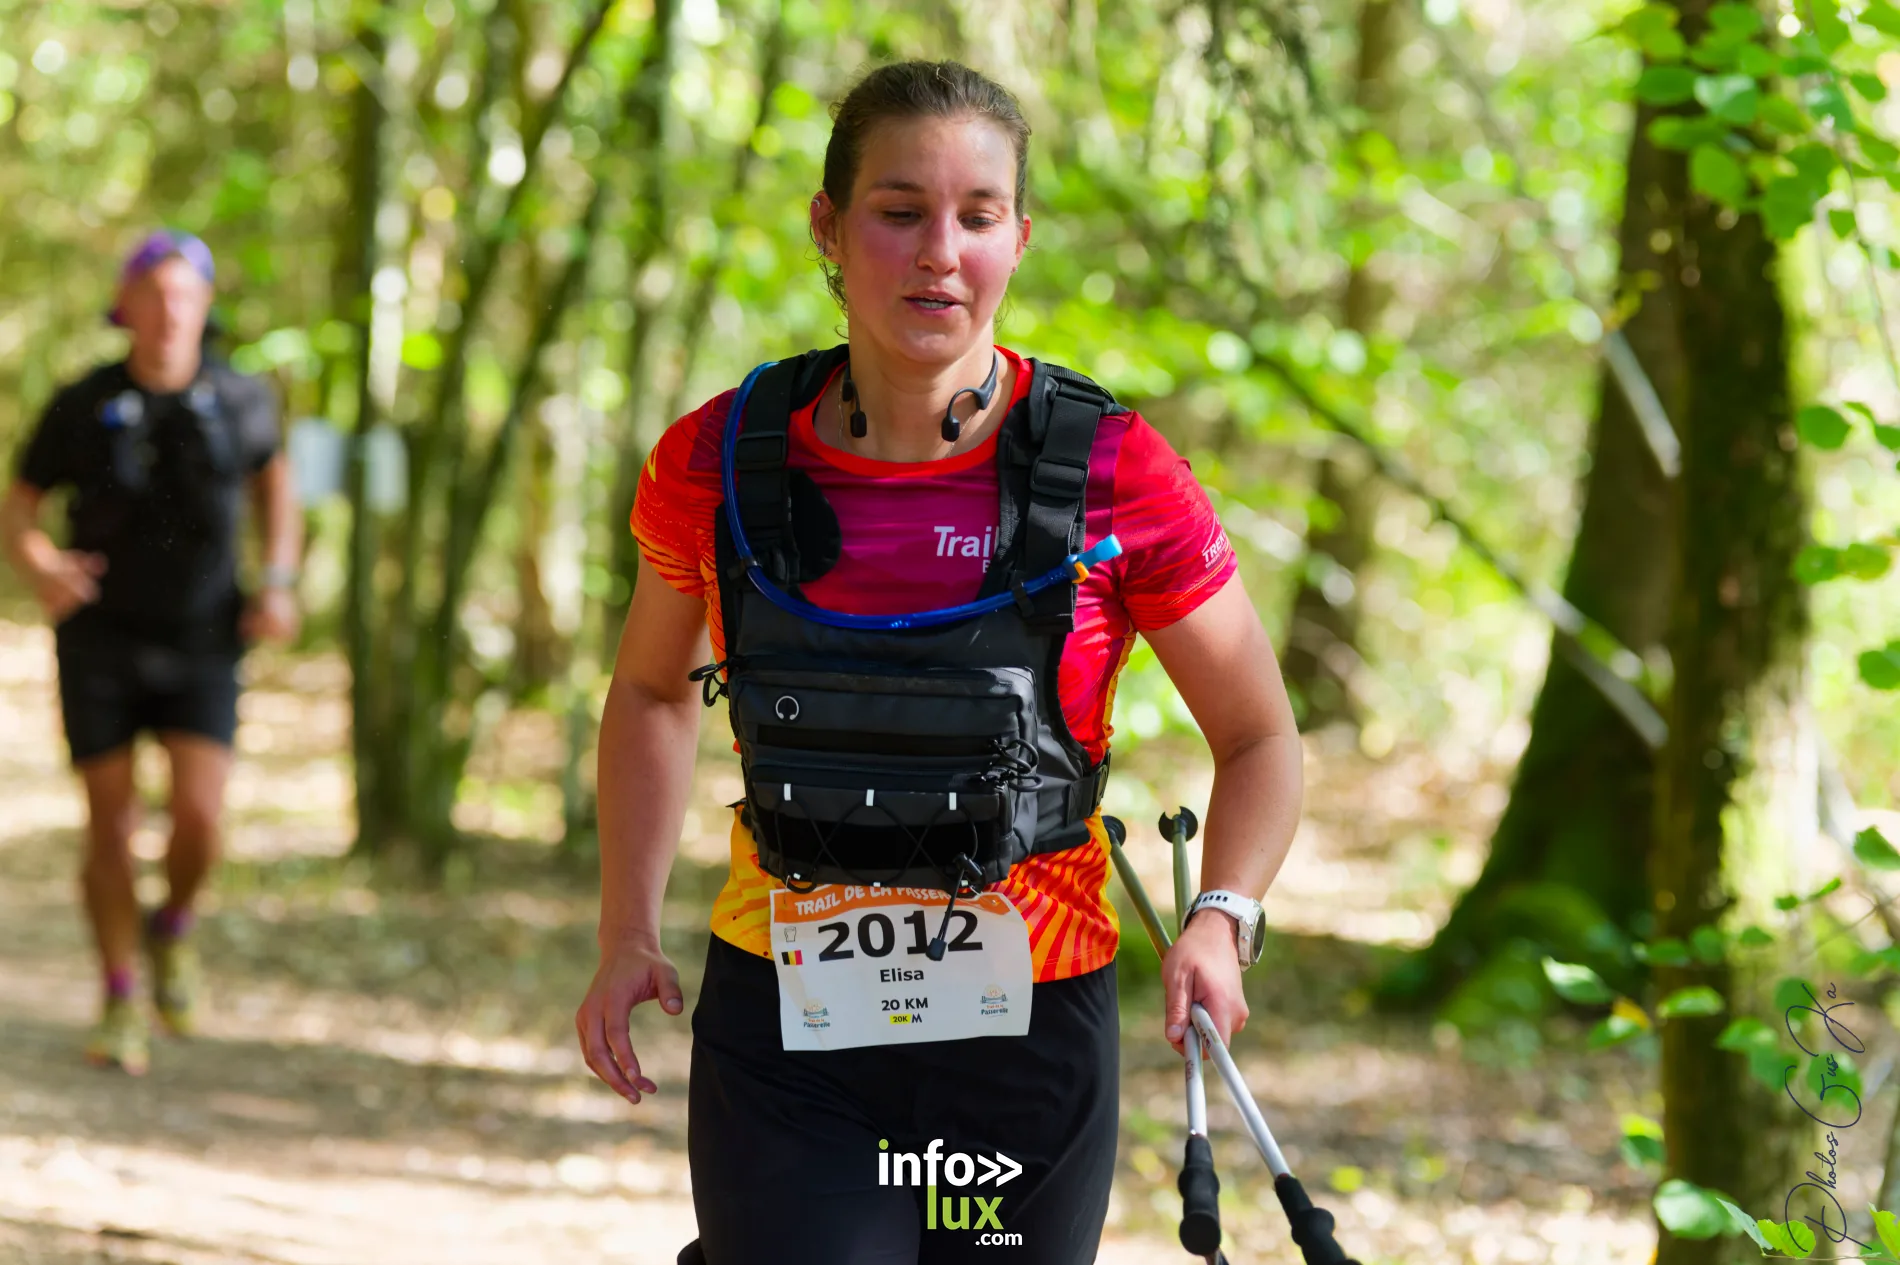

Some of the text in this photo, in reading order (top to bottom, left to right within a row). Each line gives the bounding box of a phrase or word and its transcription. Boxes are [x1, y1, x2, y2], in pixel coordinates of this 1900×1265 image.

[795, 894, 841, 916] TRAIL
[844, 886, 866, 901] DE
[870, 886, 892, 898] LA
[817, 909, 983, 962] 2012
[879, 968, 924, 982] Elisa
[881, 997, 928, 1012] 20 KM
[892, 1013, 923, 1023] 20K M
